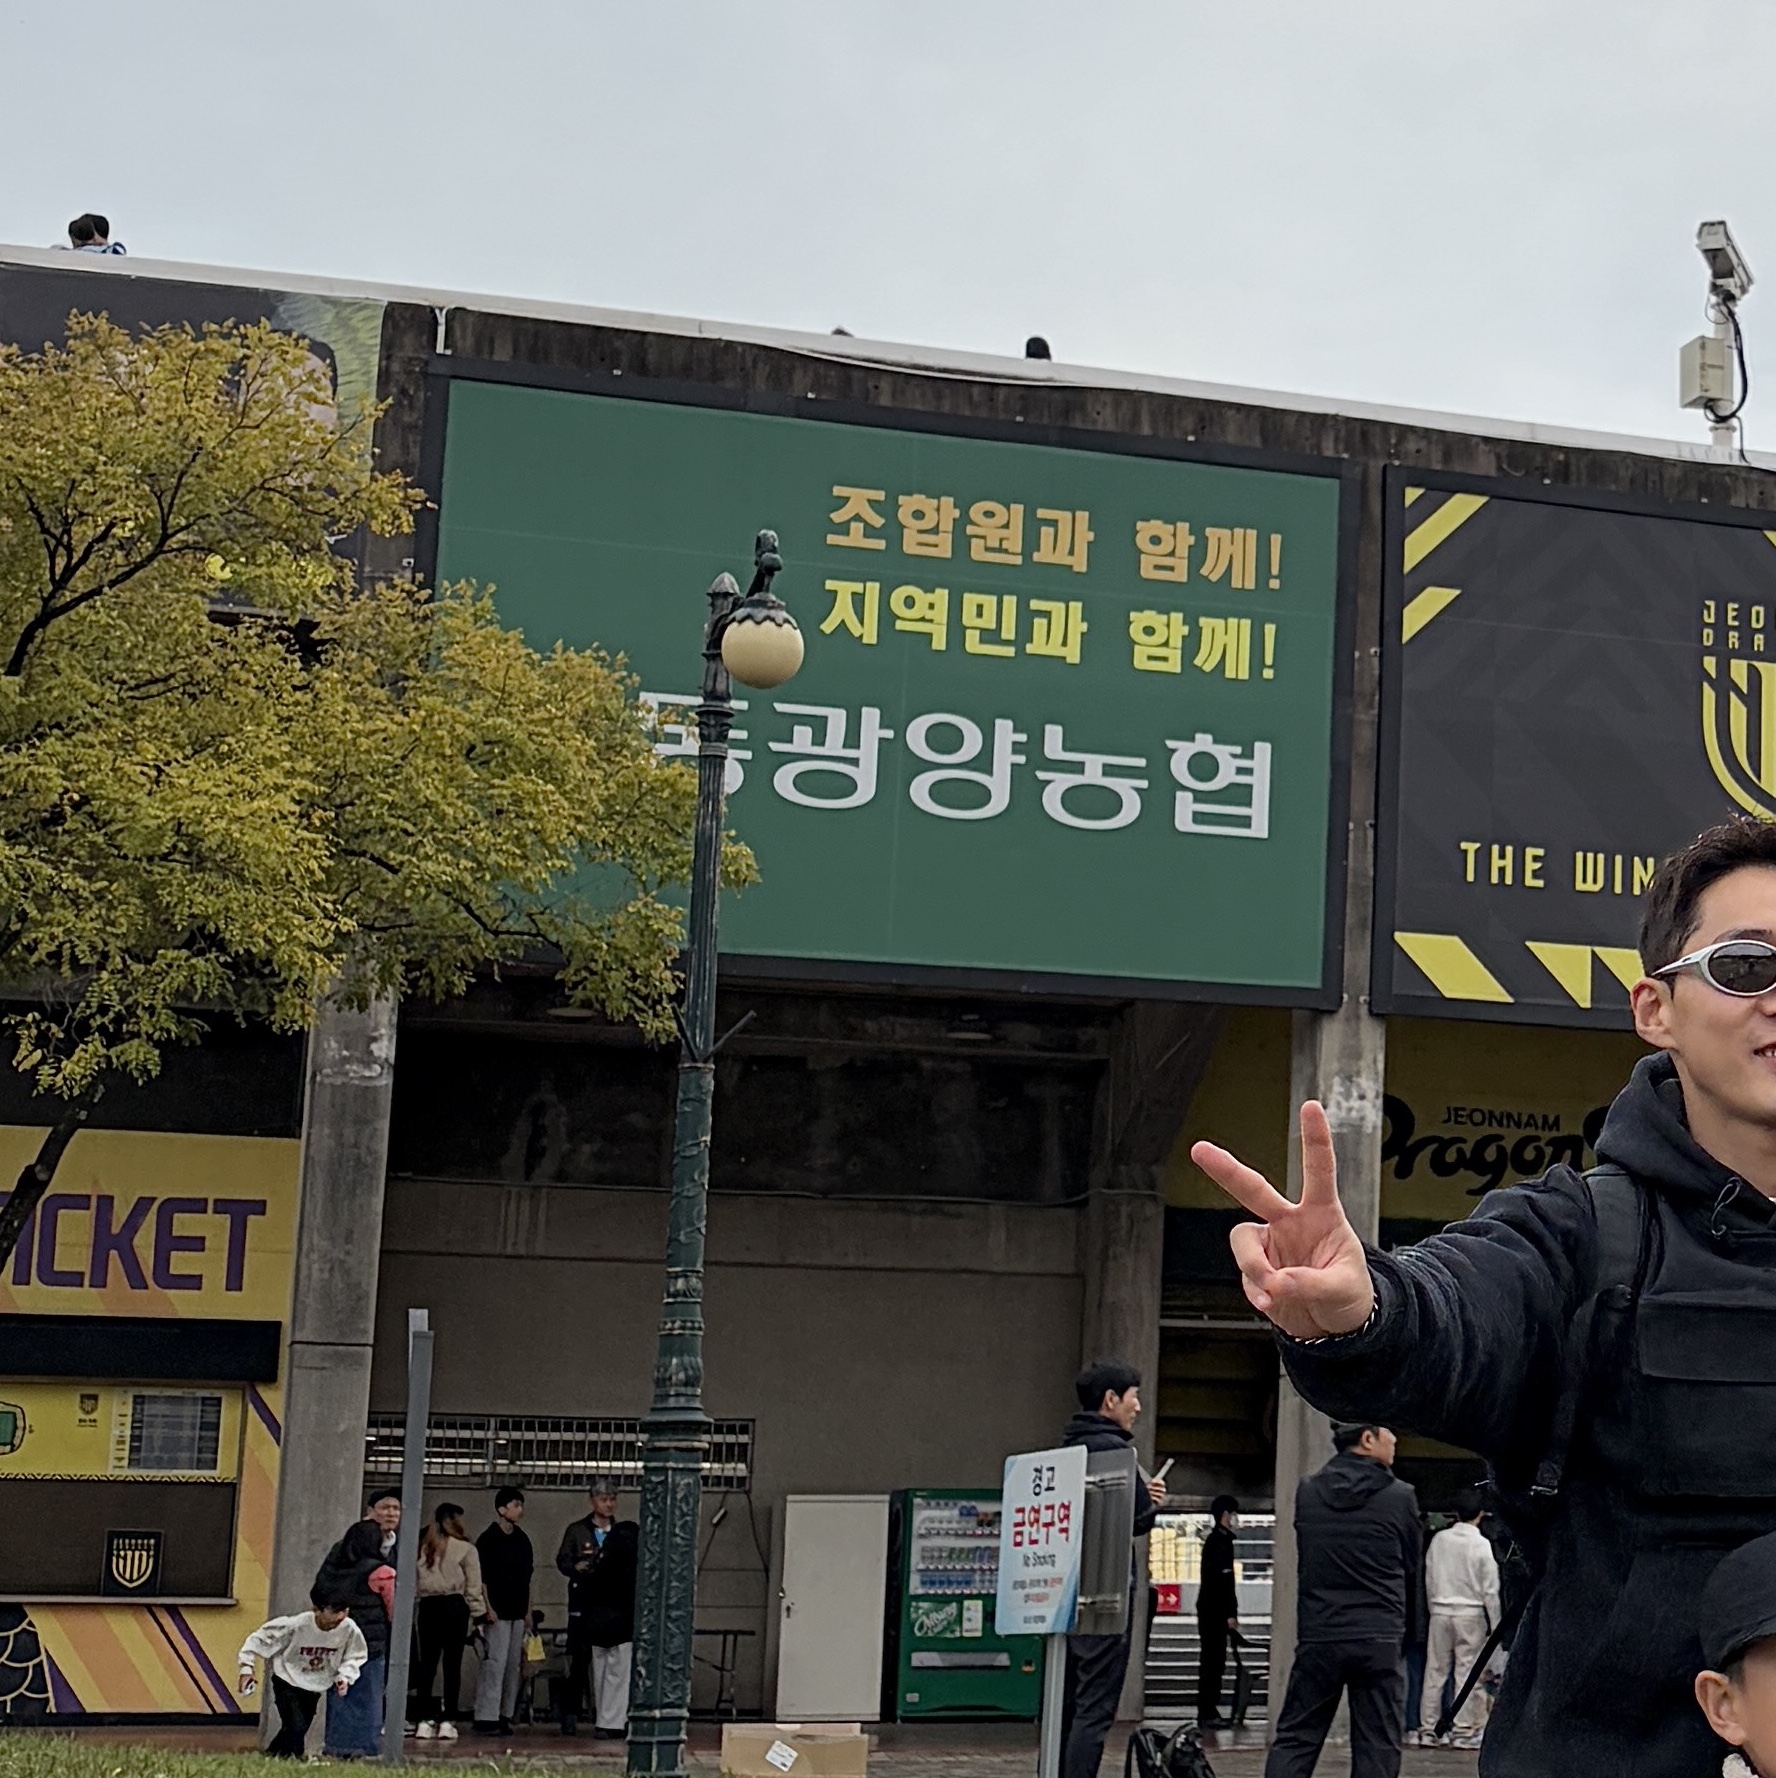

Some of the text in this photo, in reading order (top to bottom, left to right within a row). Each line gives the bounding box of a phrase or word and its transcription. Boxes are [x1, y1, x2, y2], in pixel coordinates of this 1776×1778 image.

[825, 485, 1283, 590] 조합원과 함께!
[820, 579, 1278, 680] 지역민과 함께!
[1459, 841, 1545, 888] THE
[1575, 851, 1655, 896] WIN
[1442, 1106, 1561, 1133] JEONNAM
[0, 1191, 267, 1292] ICKET
[1032, 1465, 1056, 1496] 경고
[1012, 1500, 1071, 1548] 금연구역
